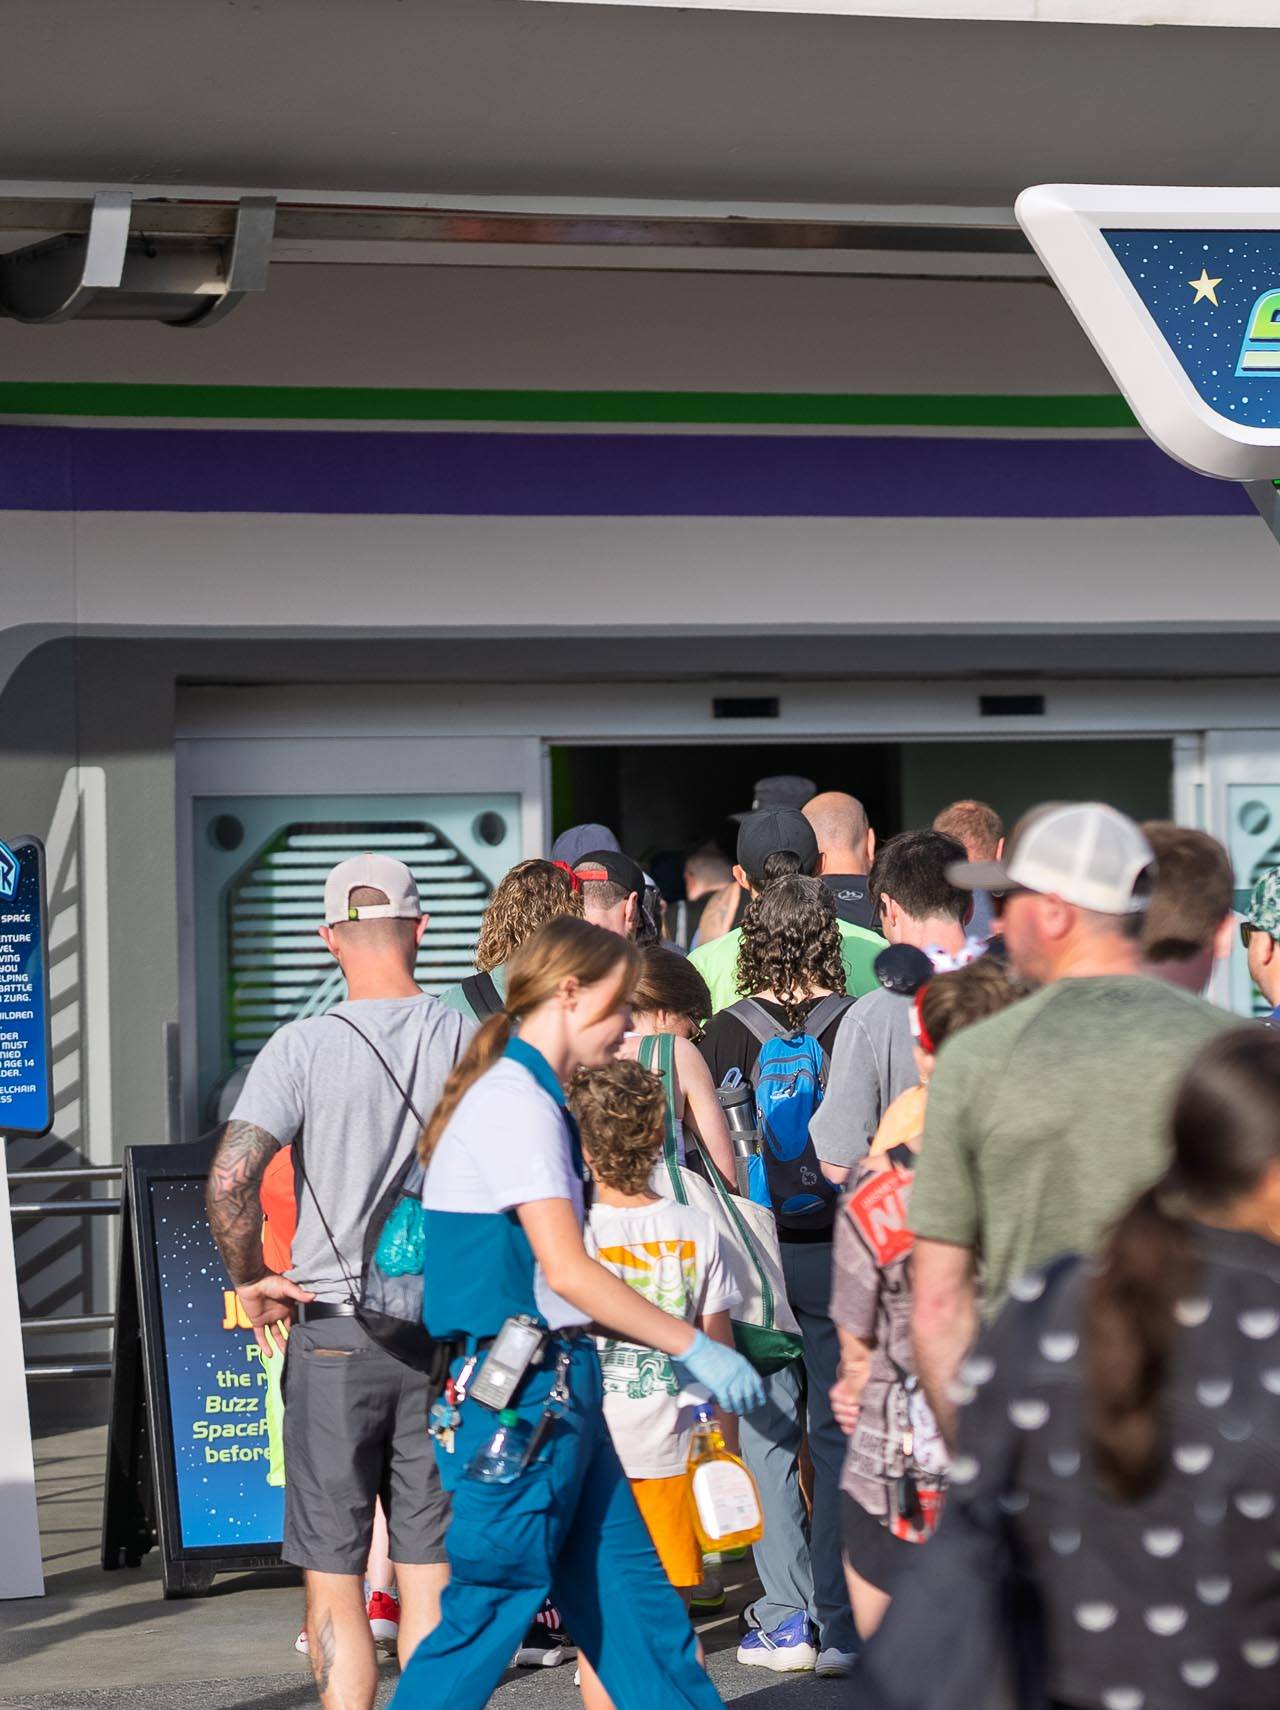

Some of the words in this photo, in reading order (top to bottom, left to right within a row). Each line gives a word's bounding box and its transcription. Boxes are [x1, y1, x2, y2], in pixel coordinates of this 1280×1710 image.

[1, 914, 31, 923] SPACE
[0, 934, 31, 942] NTURE
[3, 993, 32, 1003] ZURG.
[2, 1040, 28, 1050] MUST
[4, 1059, 23, 1068] AGE
[24, 1058, 35, 1067] 14
[216, 1370, 251, 1388] the
[205, 1395, 259, 1413] Buzz
